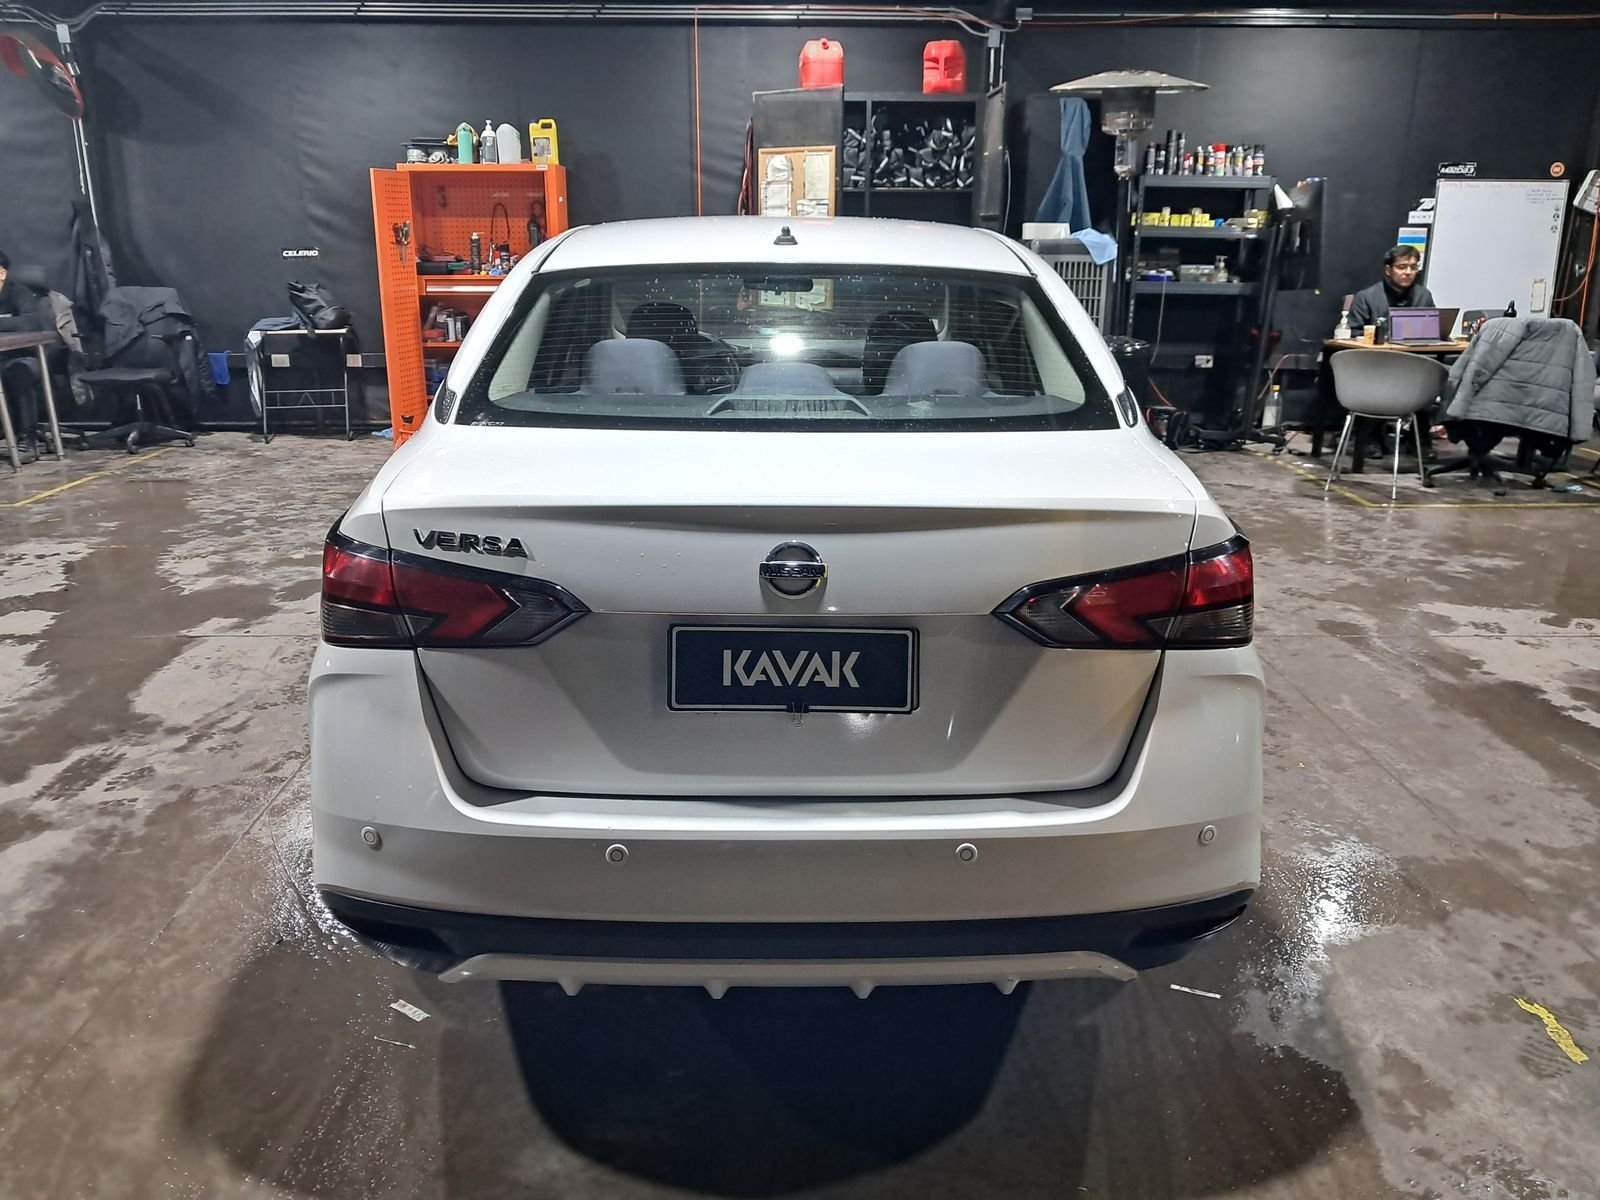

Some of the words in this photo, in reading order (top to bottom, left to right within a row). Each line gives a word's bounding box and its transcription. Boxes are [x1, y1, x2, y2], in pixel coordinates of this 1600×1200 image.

[413, 528, 528, 558] VERSA
[766, 566, 821, 577] NISSAN
[723, 649, 860, 688] KAVAK
